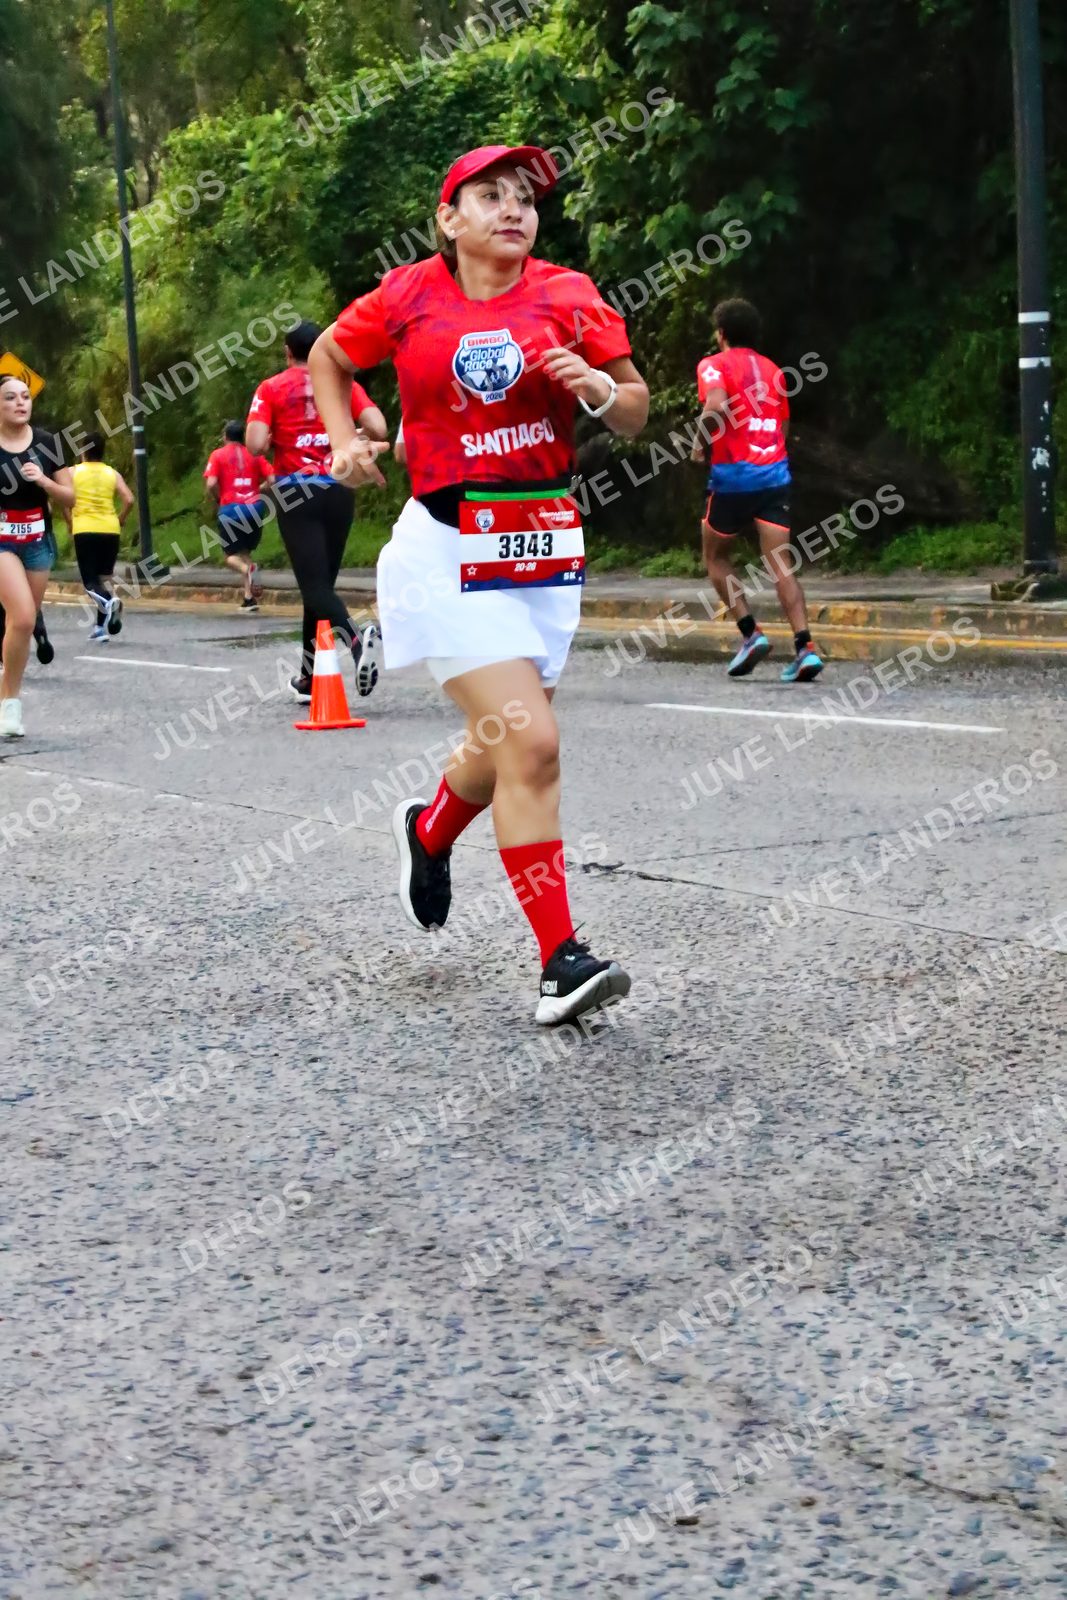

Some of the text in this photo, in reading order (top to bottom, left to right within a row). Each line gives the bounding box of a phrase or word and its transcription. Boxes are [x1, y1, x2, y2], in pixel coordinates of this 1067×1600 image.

[467, 336, 505, 347] BIMBO
[470, 346, 506, 361] Global
[464, 359, 493, 372] Race
[485, 392, 504, 402] 2026
[460, 416, 555, 457] SANTIAGO
[10, 523, 32, 534] 2155
[498, 532, 553, 559] 3343
